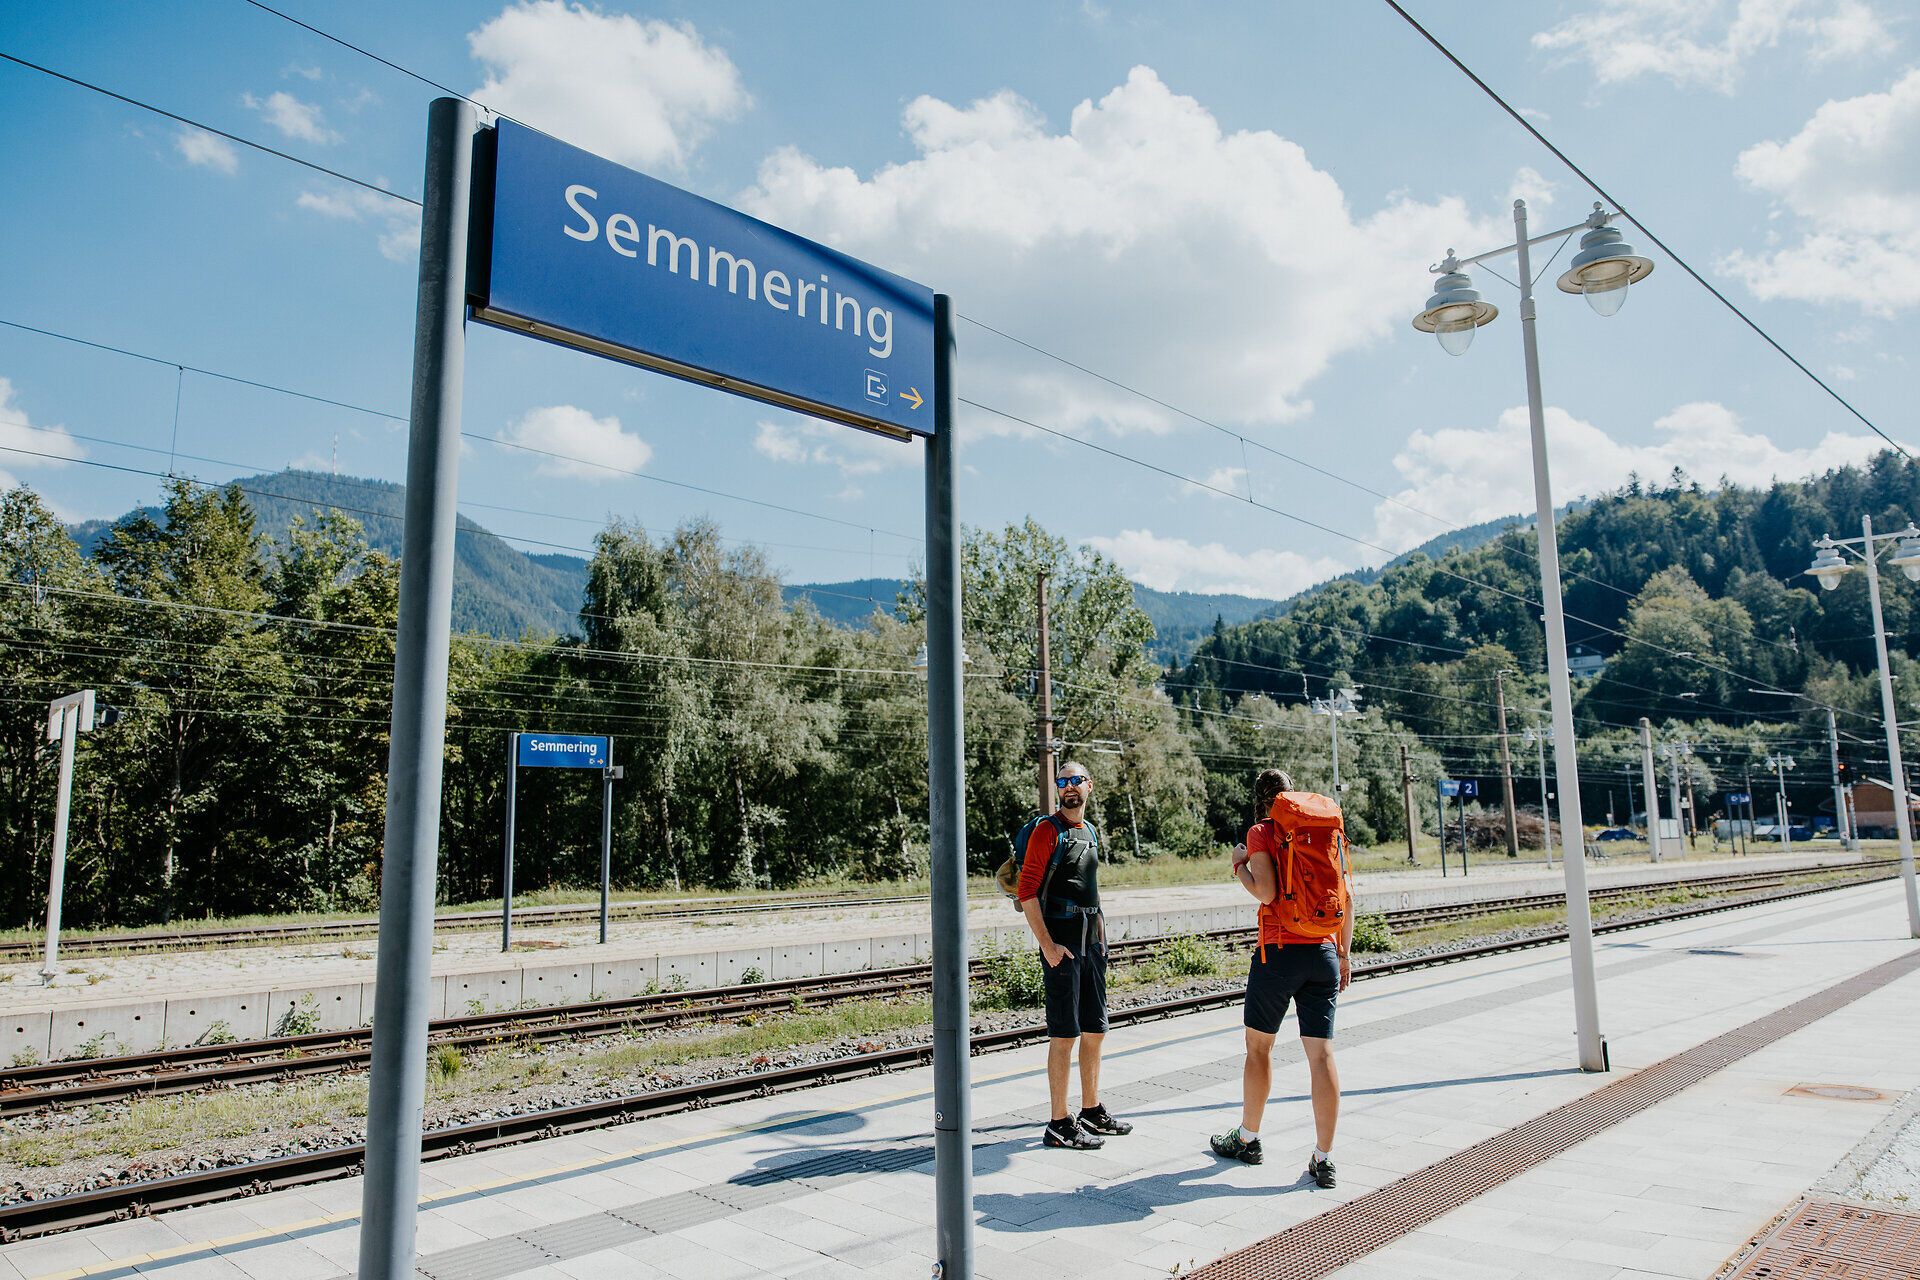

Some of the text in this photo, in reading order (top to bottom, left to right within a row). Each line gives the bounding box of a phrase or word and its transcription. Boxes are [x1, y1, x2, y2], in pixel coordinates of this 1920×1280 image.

[563, 184, 894, 359] Semmering
[530, 739, 597, 755] Semmering
[1465, 783, 1473, 794] 2
